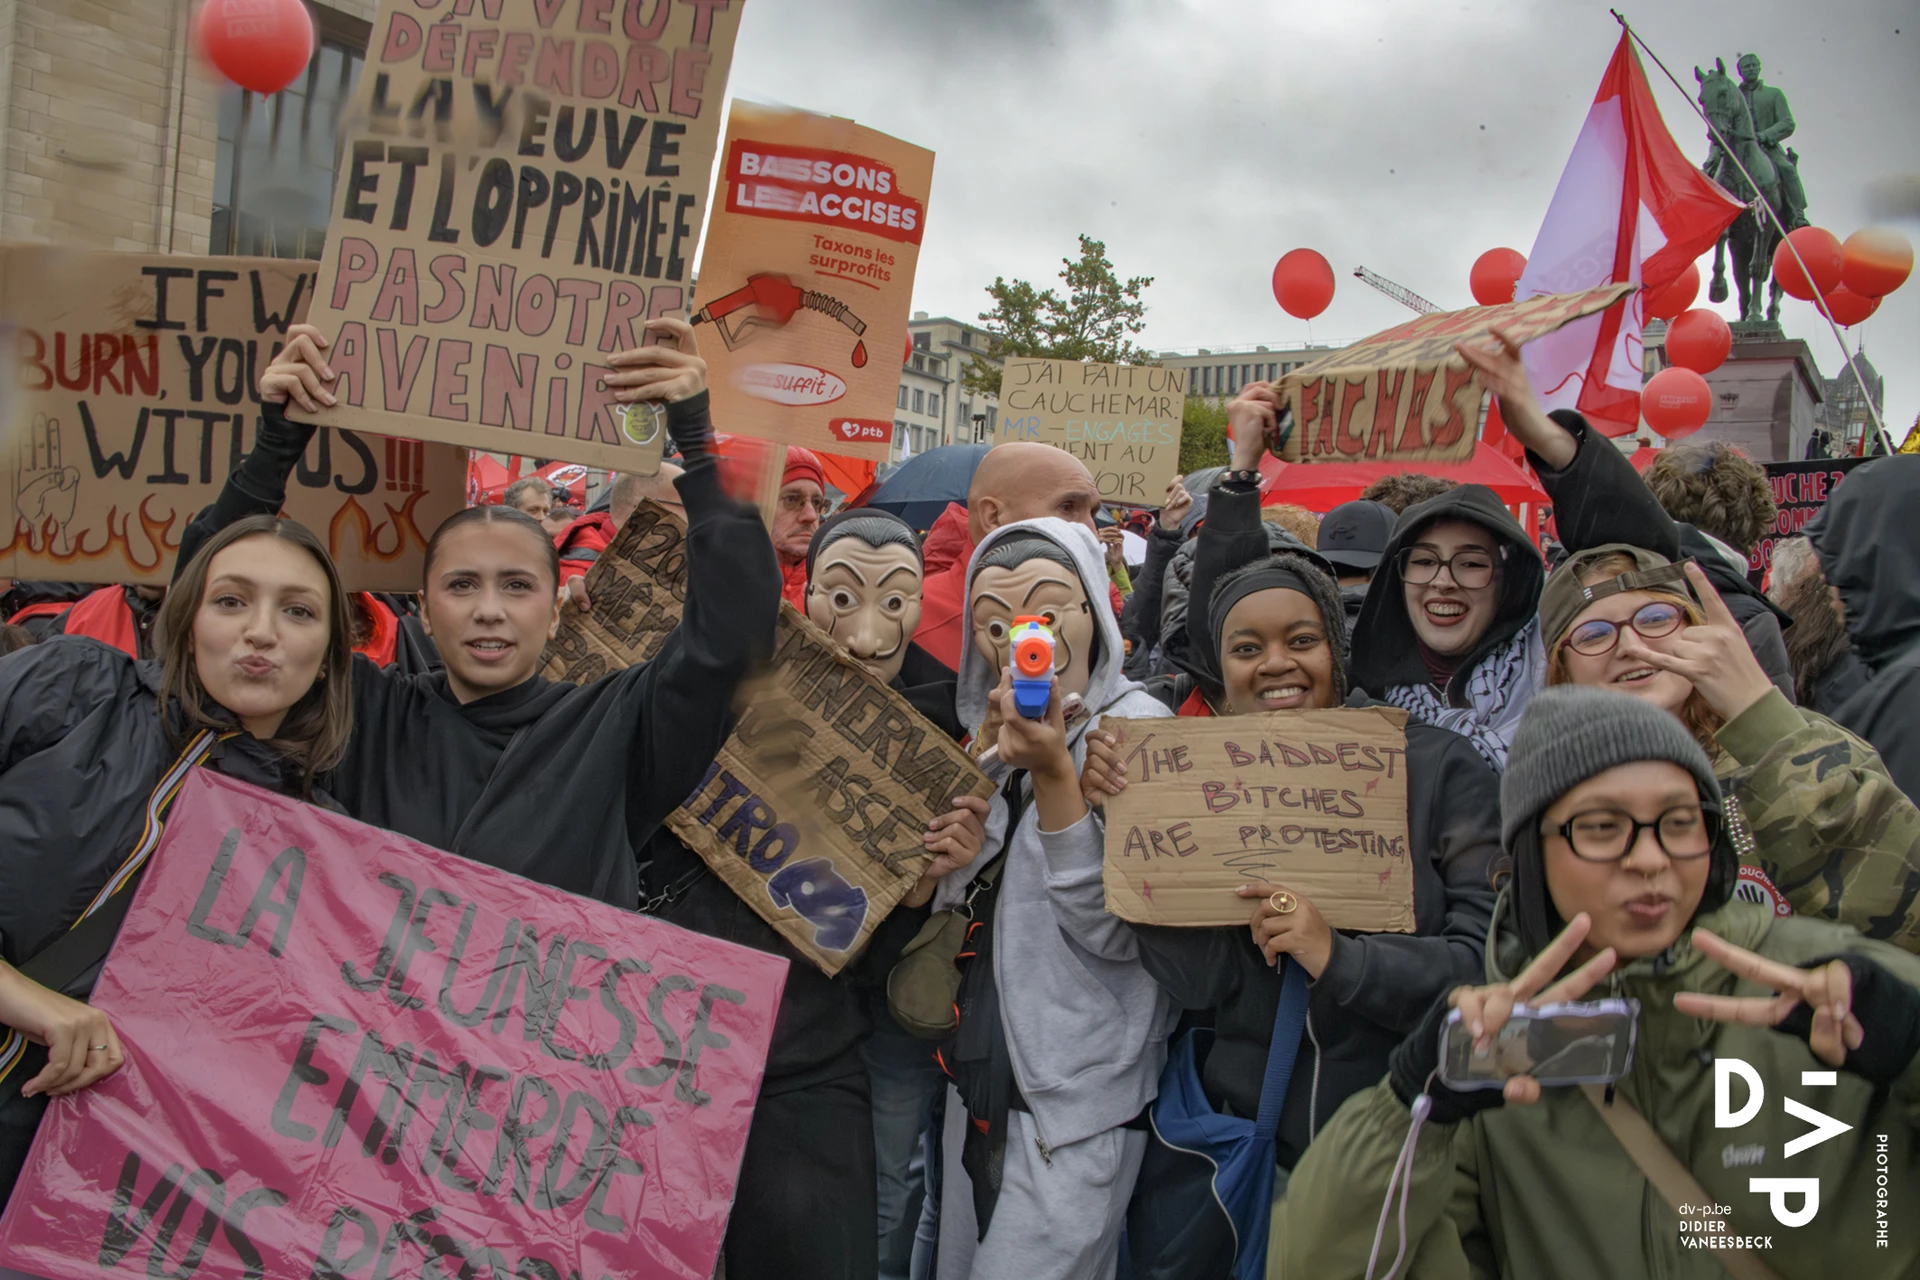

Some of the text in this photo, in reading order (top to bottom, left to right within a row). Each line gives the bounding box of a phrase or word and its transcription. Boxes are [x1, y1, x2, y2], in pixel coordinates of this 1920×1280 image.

[381, 11, 713, 118] DÉFENDRE
[342, 139, 430, 231] ET
[798, 191, 916, 231] ACCISES
[809, 253, 891, 282] surprofits
[813, 234, 895, 266] Taxons les
[135, 266, 319, 333] IF W
[1011, 360, 1185, 393] J'AI FAIT UN
[862, 425, 883, 438] ptb
[1120, 445, 1155, 464] AU
[1123, 733, 1406, 782] THE BADDEST
[1123, 821, 1199, 861] ARE
[186, 828, 746, 1106] LA JEUNESSE
[270, 1013, 653, 1233] EMMERDE
